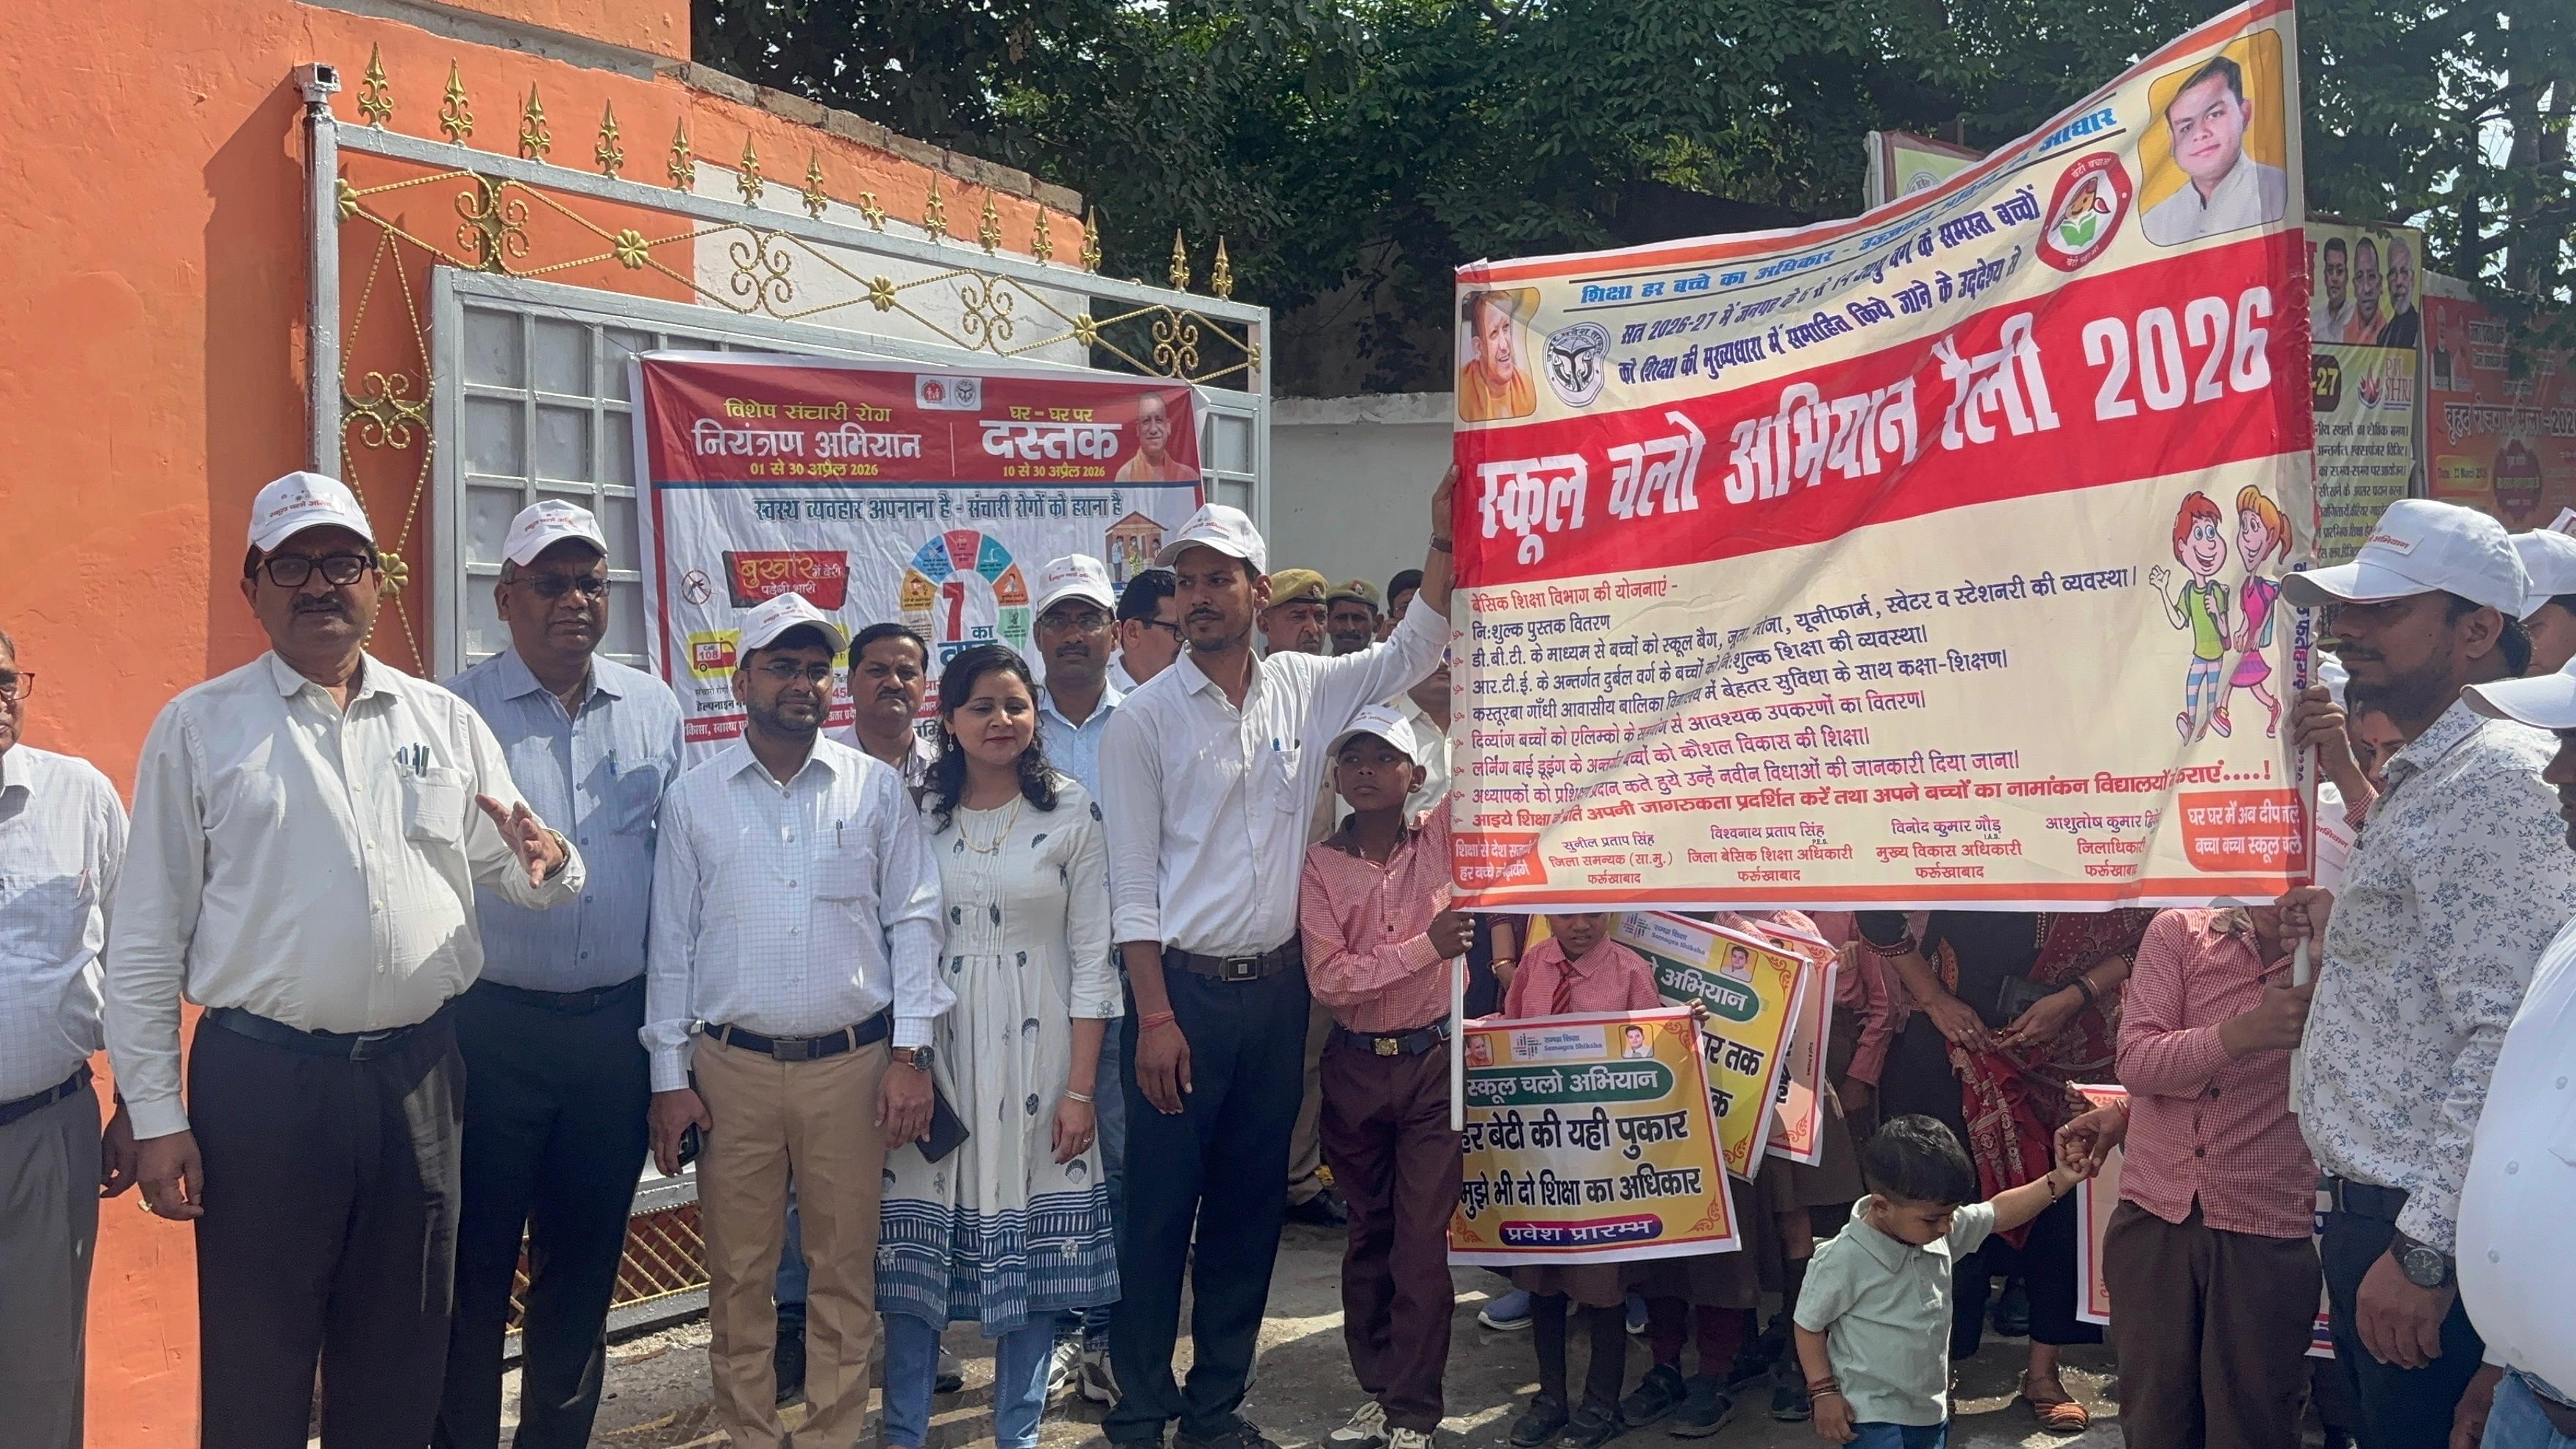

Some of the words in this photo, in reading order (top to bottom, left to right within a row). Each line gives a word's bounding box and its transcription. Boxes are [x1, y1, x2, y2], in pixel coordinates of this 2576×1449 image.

[1581, 284, 1633, 304] शिक्षा
[1641, 280, 1665, 298] हर
[1674, 273, 1712, 293] बच्चे
[1720, 271, 1747, 287] का
[1754, 249, 1835, 281] अधिकार
[2037, 107, 2117, 152] आधार
[1647, 311, 1718, 340] 2026-27
[1719, 302, 1741, 326] में
[1918, 227, 1934, 257] के
[1939, 210, 1996, 249] समस्त
[1992, 184, 2040, 226] बच्चों
[1619, 358, 1636, 385] को
[1641, 355, 1678, 383] शिक्षा
[1680, 343, 1698, 376] की
[1703, 336, 1767, 380] मुख्यधारा
[1769, 323, 1787, 354] में
[1847, 296, 1895, 328] किये
[1892, 280, 1933, 317] जाने
[1934, 271, 1952, 304] के
[2386, 378, 2412, 401] SHRI
[724, 398, 776, 419] विशेष
[785, 401, 848, 421] संचारी
[855, 403, 891, 422] रोग
[1009, 406, 1031, 421] घर
[1048, 408, 1069, 422] घर
[1072, 409, 1093, 422] पर
[1477, 453, 1588, 565] स्कूल
[1609, 410, 1706, 520] चलो
[1723, 381, 1919, 505] अभियान
[1931, 312, 2060, 451] रैली
[2082, 285, 2273, 422] 2026
[691, 418, 804, 457] नियंत्रण
[815, 422, 921, 459] अभियान
[979, 420, 1122, 460] दस्तक
[750, 463, 764, 475] 01
[771, 458, 785, 476] से
[790, 463, 804, 476] 30
[808, 459, 846, 477] अप्रैल
[850, 463, 878, 476] 2026
[1003, 466, 1014, 476] 10
[1018, 463, 1029, 477] से
[1034, 467, 1045, 476] 30
[1048, 462, 1079, 478] अप्रैल
[1083, 466, 1105, 477] 2026
[755, 499, 799, 520] स्वस्थ
[805, 499, 863, 520] व्यवहार
[869, 499, 933, 520] अपनाना
[939, 491, 951, 518] है
[967, 493, 1010, 518] संचारी
[1015, 492, 1044, 518] रोगों
[1048, 492, 1066, 516] को
[1071, 498, 1108, 517] हराना
[1112, 490, 1123, 516] है
[741, 553, 814, 588] बुखार
[793, 580, 816, 594] भारी
[1471, 594, 1509, 613] बेसिक
[1510, 589, 1546, 609] शिक्षा
[1548, 585, 1590, 605] विभाग
[1593, 580, 1611, 602] की
[1615, 574, 1667, 599] योजनाएं
[943, 582, 964, 641] 7
[971, 625, 994, 639] का
[1472, 645, 1526, 668] डी.बी.टी.
[1531, 643, 1543, 664] के
[1547, 644, 1590, 661] माध्यम
[1595, 638, 1606, 659] से
[1610, 634, 1638, 658] बच्चों
[1642, 632, 1658, 655] को
[1663, 634, 1693, 658] स्कूल
[1885, 589, 1933, 613] स्वेटर
[1936, 590, 1950, 607] व
[1954, 574, 2028, 605] स्टेशनरी
[2030, 571, 2057, 596] की
[1527, 618, 1566, 642] पुस्तक
[1570, 613, 1610, 632] वितरण
[699, 651, 718, 659] 108
[1472, 813, 1513, 828] आइये
[1516, 809, 1551, 827] शिक्षा
[1588, 800, 1636, 820] अपनी
[1736, 787, 1795, 811] प्रदर्शित
[1800, 786, 1831, 806] करें
[1834, 790, 1868, 804] तथा
[1873, 782, 1919, 804] अपने
[1924, 779, 1971, 800] बच्चों
[1974, 782, 2002, 798] का
[2007, 775, 2089, 798] नामांकन
[2094, 769, 2171, 794] विद्यालयों
[2187, 808, 2205, 825] घर
[2207, 807, 2223, 825] घर
[2224, 801, 2238, 825] में
[2239, 806, 2256, 824] अब
[2258, 798, 2281, 824] दीप
[1562, 837, 1597, 853] सुनील
[1601, 834, 1629, 847] प्रताप
[1632, 831, 1655, 846] सिंह
[2195, 836, 2220, 855] बच्चा
[2223, 836, 2245, 854] बच्चा
[2247, 836, 2280, 864] स्कूल
[2283, 829, 2302, 855] चले
[1660, 968, 1749, 1011] अभियान
[1544, 1044, 1573, 1052] Samagra
[1575, 1042, 1603, 1051] Shiksha
[1724, 1041, 1764, 1077] तक
[1467, 1077, 1516, 1104] स्कूल
[1520, 1069, 1563, 1094] चलो
[1570, 1066, 1658, 1092] अभियान
[1487, 1109, 1524, 1149] बेटी
[1530, 1108, 1561, 1148] की
[1567, 1107, 1609, 1150] यही
[1615, 1110, 1688, 1160] पुकार
[1494, 1169, 1513, 1206] भी
[1516, 1171, 1535, 1206] दो
[1540, 1169, 1581, 1205] शिक्षा
[1584, 1178, 1614, 1203] का
[1620, 1163, 1701, 1201] अधिकार
[1505, 1223, 1562, 1241] प्रवेश
[1569, 1219, 1653, 1240] प्रारम्भ
